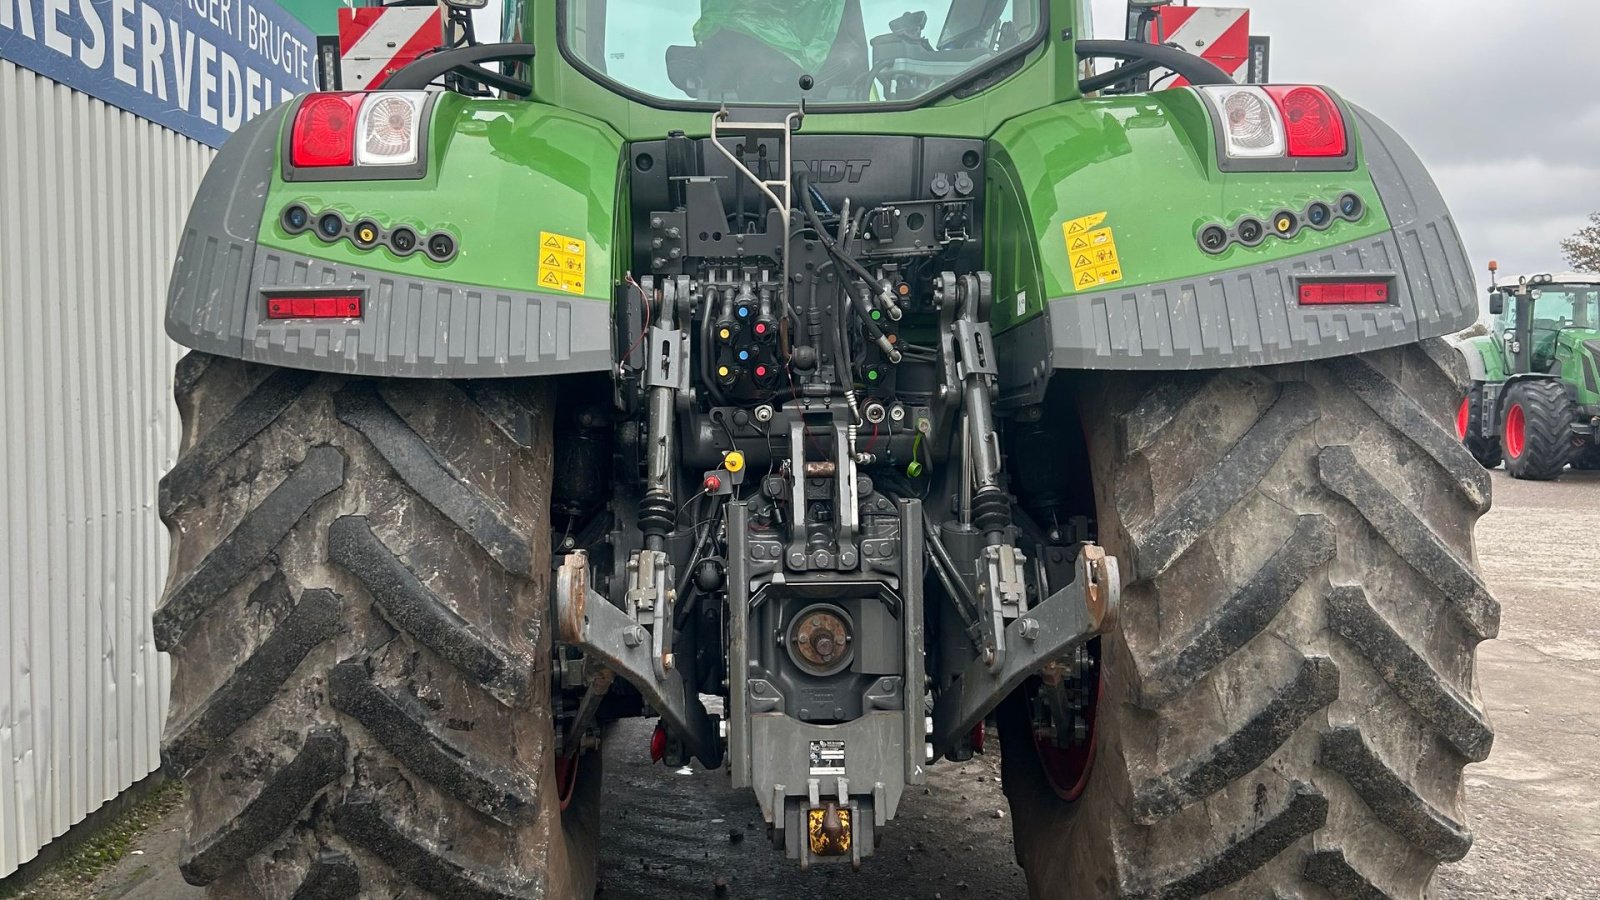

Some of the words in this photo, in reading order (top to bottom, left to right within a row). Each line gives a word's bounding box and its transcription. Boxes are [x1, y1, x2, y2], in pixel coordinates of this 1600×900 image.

[0, 0, 294, 132] ESERVEDE
[187, 0, 232, 35] ER
[248, 4, 308, 85] BRUGTE
